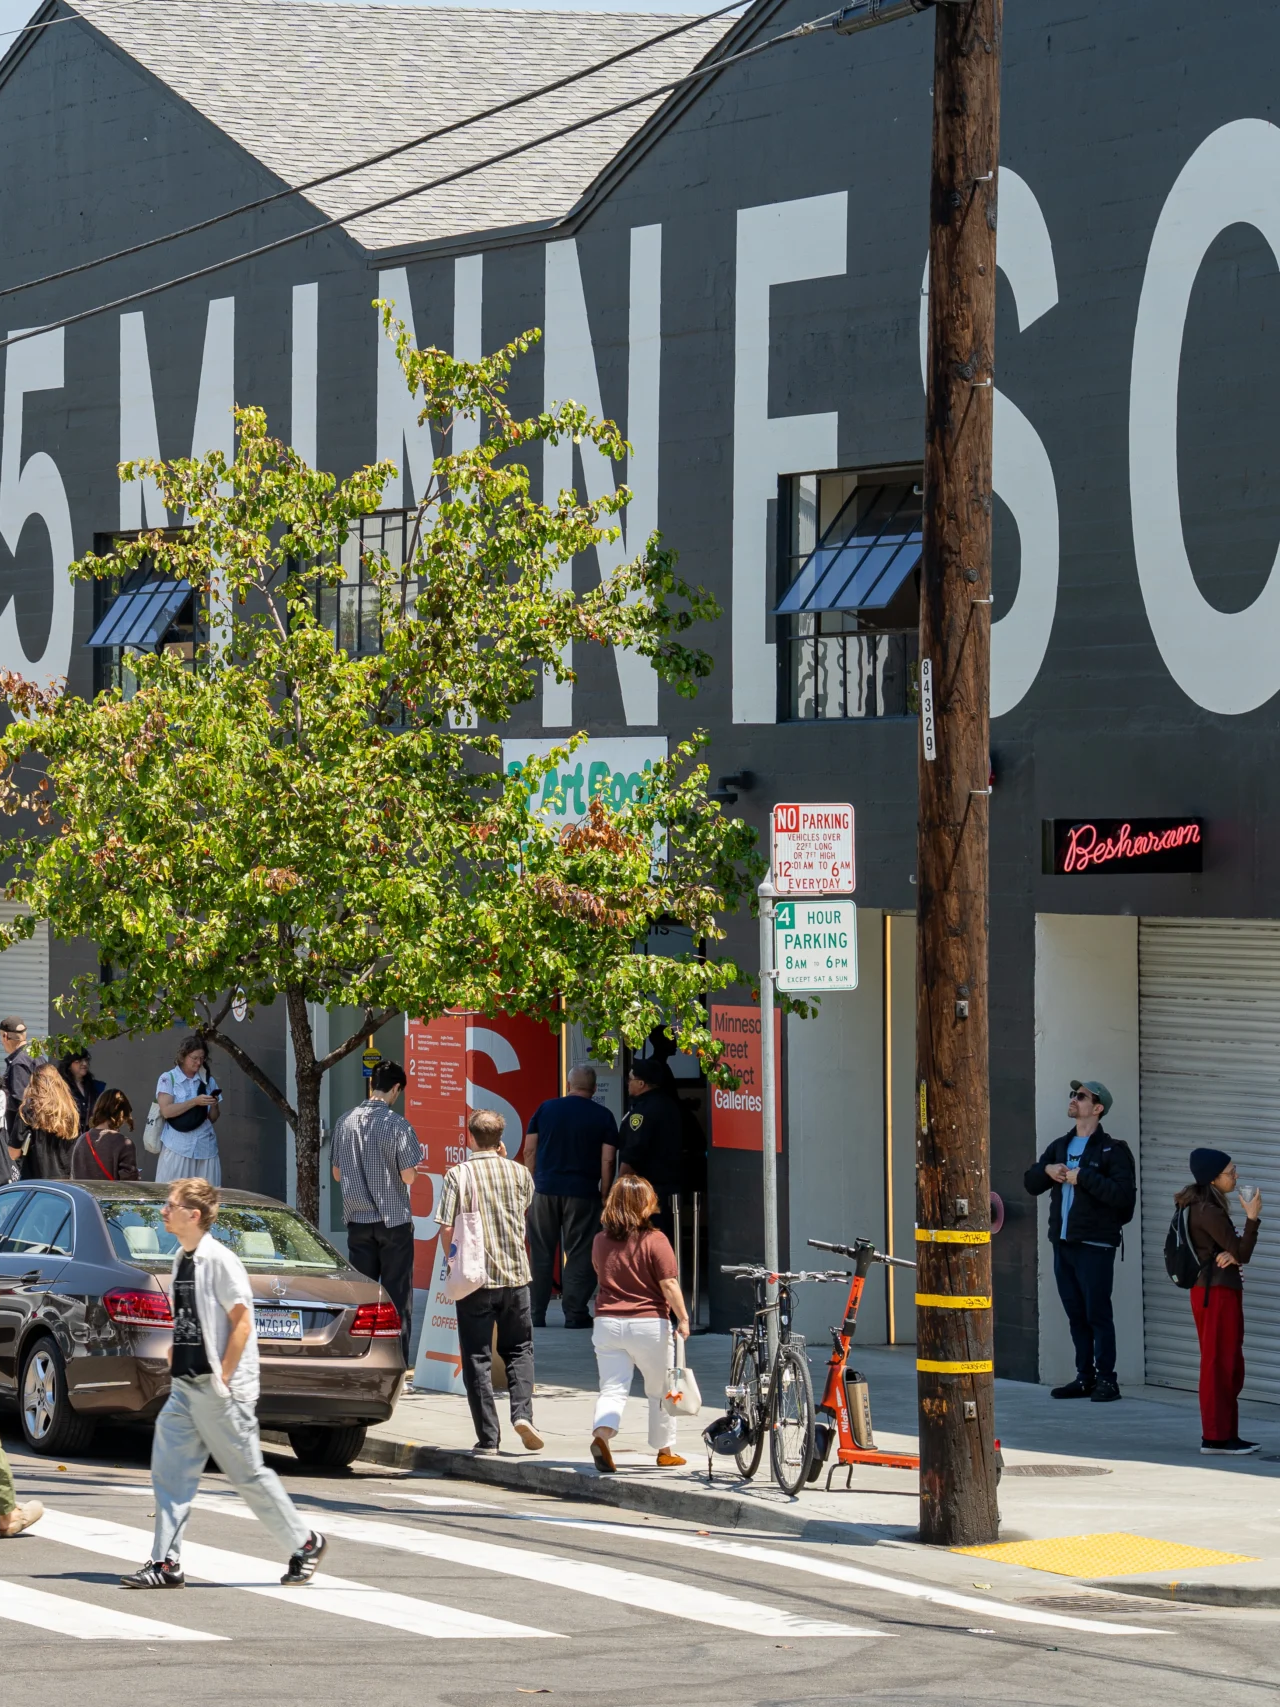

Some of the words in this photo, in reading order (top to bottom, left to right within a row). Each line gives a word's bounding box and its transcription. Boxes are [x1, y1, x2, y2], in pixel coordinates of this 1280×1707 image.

[923, 661, 933, 751] 84329
[542, 762, 586, 815] Art
[777, 807, 797, 830] NO
[802, 813, 849, 830] PARKING
[788, 833, 820, 842] VEHICLES
[822, 833, 841, 841] OVER
[814, 842, 832, 851] LONG
[793, 852, 803, 860] OR
[819, 851, 836, 860] HIGH
[1063, 823, 1201, 872] Besharam
[818, 861, 828, 870] TO
[788, 878, 841, 890] EVERYDAY
[777, 906, 791, 926] 4
[807, 910, 841, 925] HOUR
[784, 932, 848, 950] PARKING
[714, 1012, 761, 1034] Minneso
[410, 1033, 415, 1050] 1
[409, 1058, 416, 1076] 2
[714, 1088, 762, 1113] Galleries
[444, 1145, 465, 1164] 1150
[431, 1315, 458, 1331] COFFEE
[841, 1408, 849, 1433] SPIN
